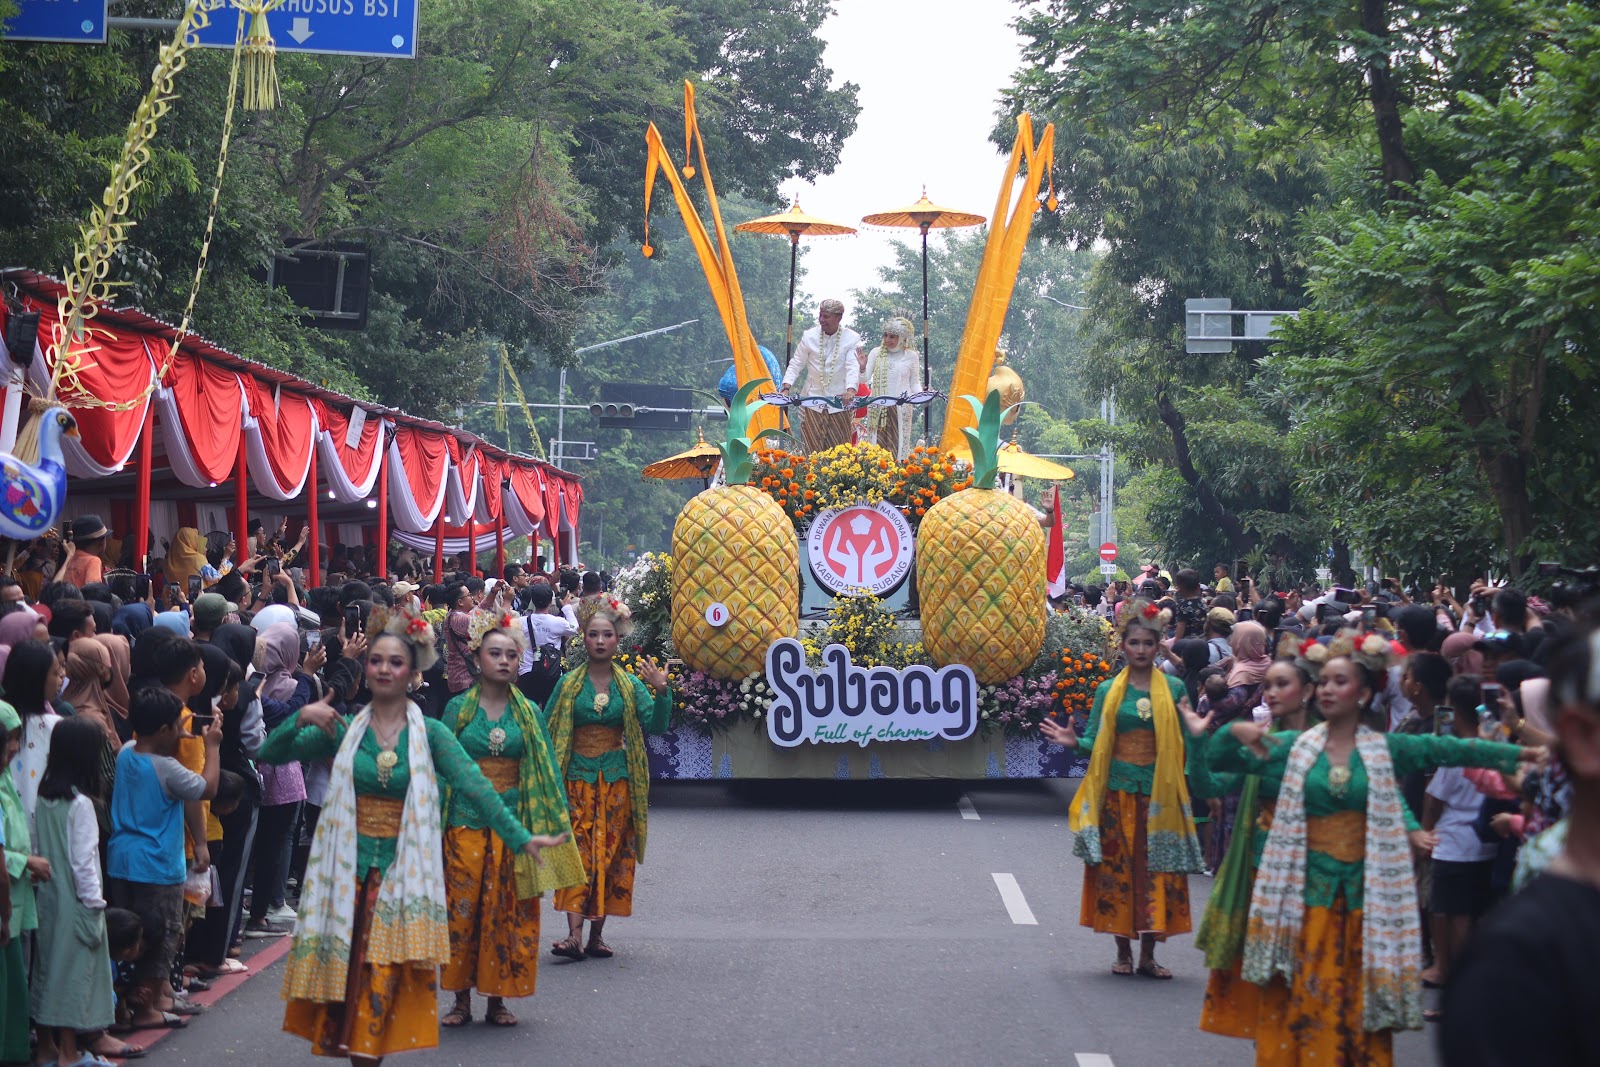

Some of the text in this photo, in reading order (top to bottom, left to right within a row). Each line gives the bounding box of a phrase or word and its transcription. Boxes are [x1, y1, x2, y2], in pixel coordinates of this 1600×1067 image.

[814, 499, 908, 541] DEWAN KJINAN NASIONAL
[872, 560, 907, 593] SUBANG
[713, 607, 721, 622] 6
[771, 642, 971, 742] Subang
[814, 721, 935, 745] Full of charm
